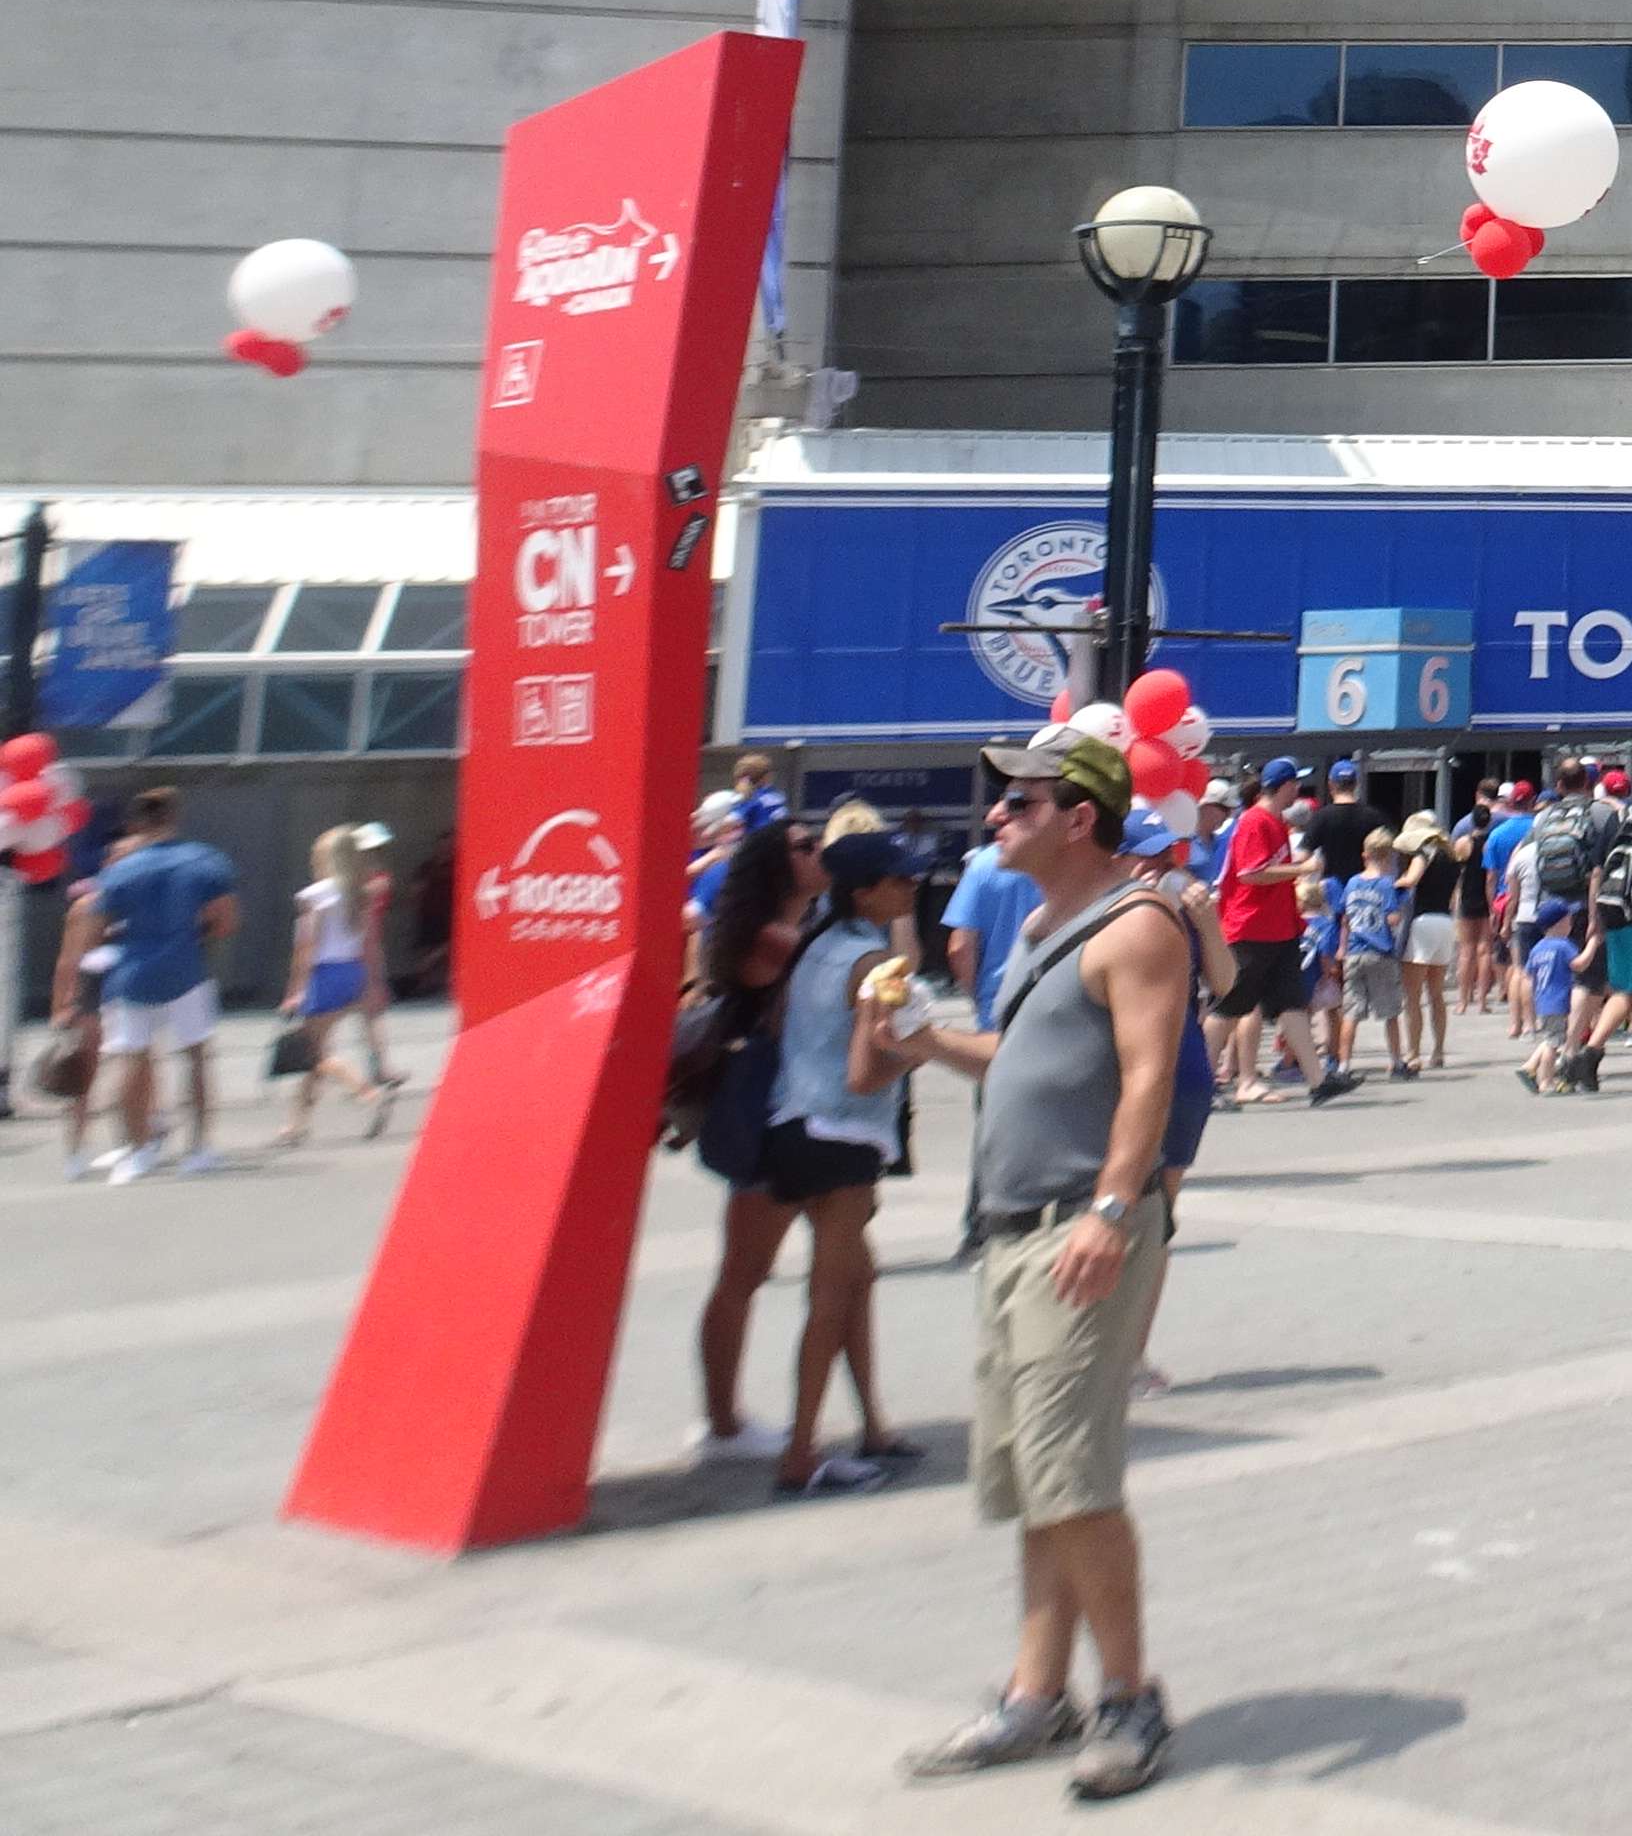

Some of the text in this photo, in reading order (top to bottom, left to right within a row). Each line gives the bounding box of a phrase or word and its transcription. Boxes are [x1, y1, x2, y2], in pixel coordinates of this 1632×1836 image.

[514, 525, 597, 613] CN
[988, 633, 1057, 691] BLUE
[1327, 656, 1367, 726] 6
[1418, 655, 1451, 724] 6
